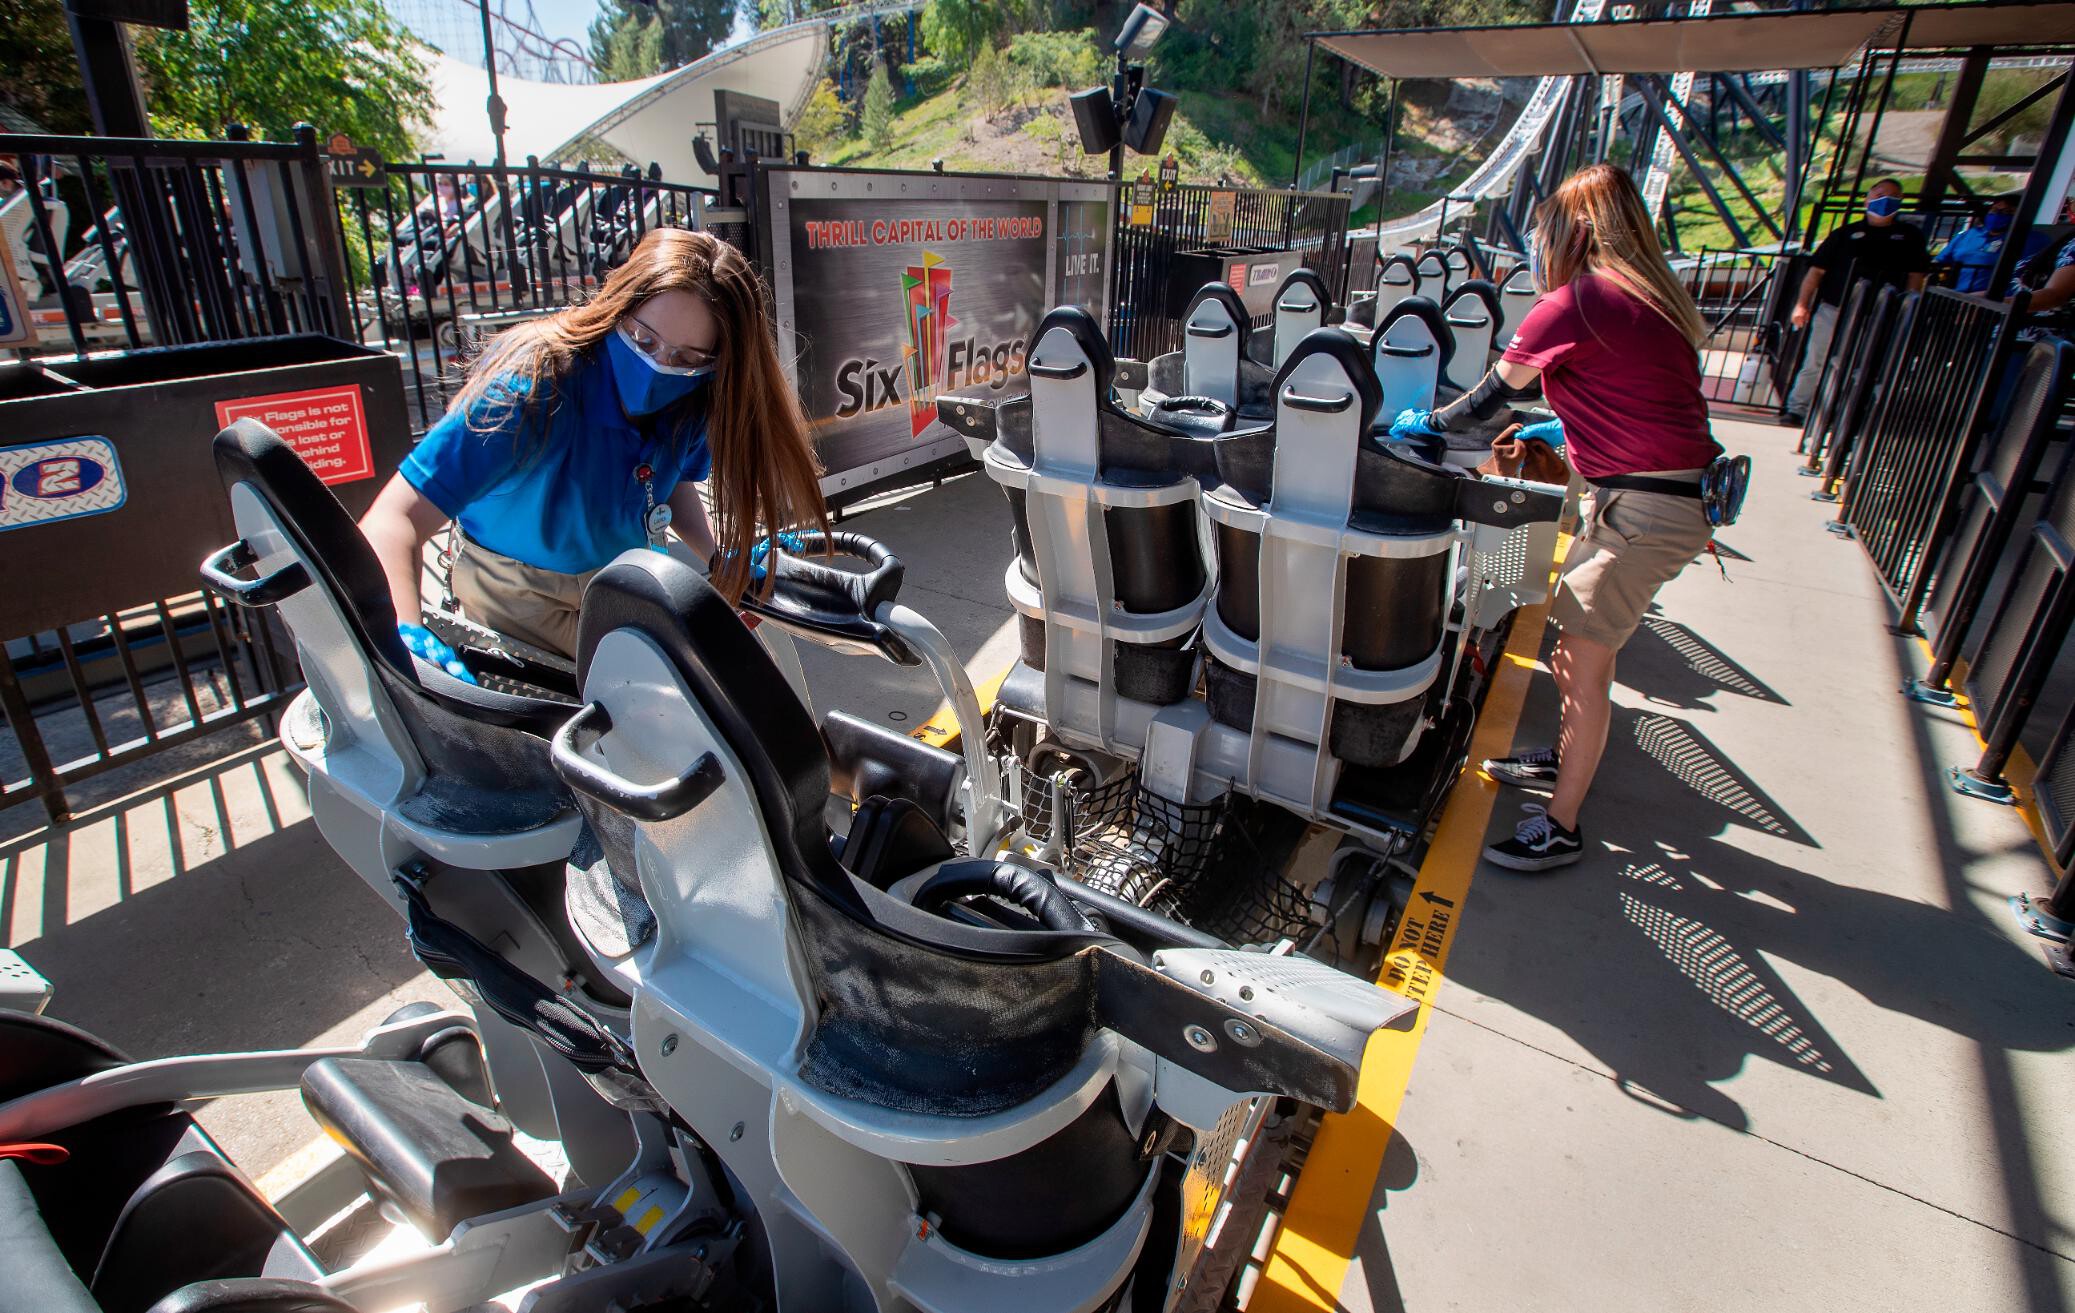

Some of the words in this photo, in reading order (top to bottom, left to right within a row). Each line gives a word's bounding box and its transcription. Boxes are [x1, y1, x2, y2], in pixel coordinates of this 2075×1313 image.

[327, 160, 354, 176] XIT
[1162, 168, 1177, 180] EXIT
[806, 220, 867, 248] THRILL
[872, 220, 943, 244] CAPITAL
[947, 219, 966, 241] OF
[970, 218, 995, 240] THE
[997, 216, 1042, 239] WORLD
[1065, 254, 1086, 276] LIVE
[1089, 253, 1100, 274] IT.
[835, 358, 903, 419] Six
[947, 336, 1026, 391] Flags
[265, 411, 306, 423] Flags
[309, 407, 320, 416] is
[324, 404, 349, 414] not
[276, 420, 327, 434] onsible
[331, 417, 352, 426] for
[299, 434, 327, 445] lost
[330, 432, 346, 440] or
[310, 458, 346, 469] iding.
[38, 458, 80, 497] 2
[1387, 955, 1411, 984] DO
[1399, 917, 1424, 949] NOT
[1405, 960, 1432, 1001] TEP
[1420, 909, 1450, 959] HERE
